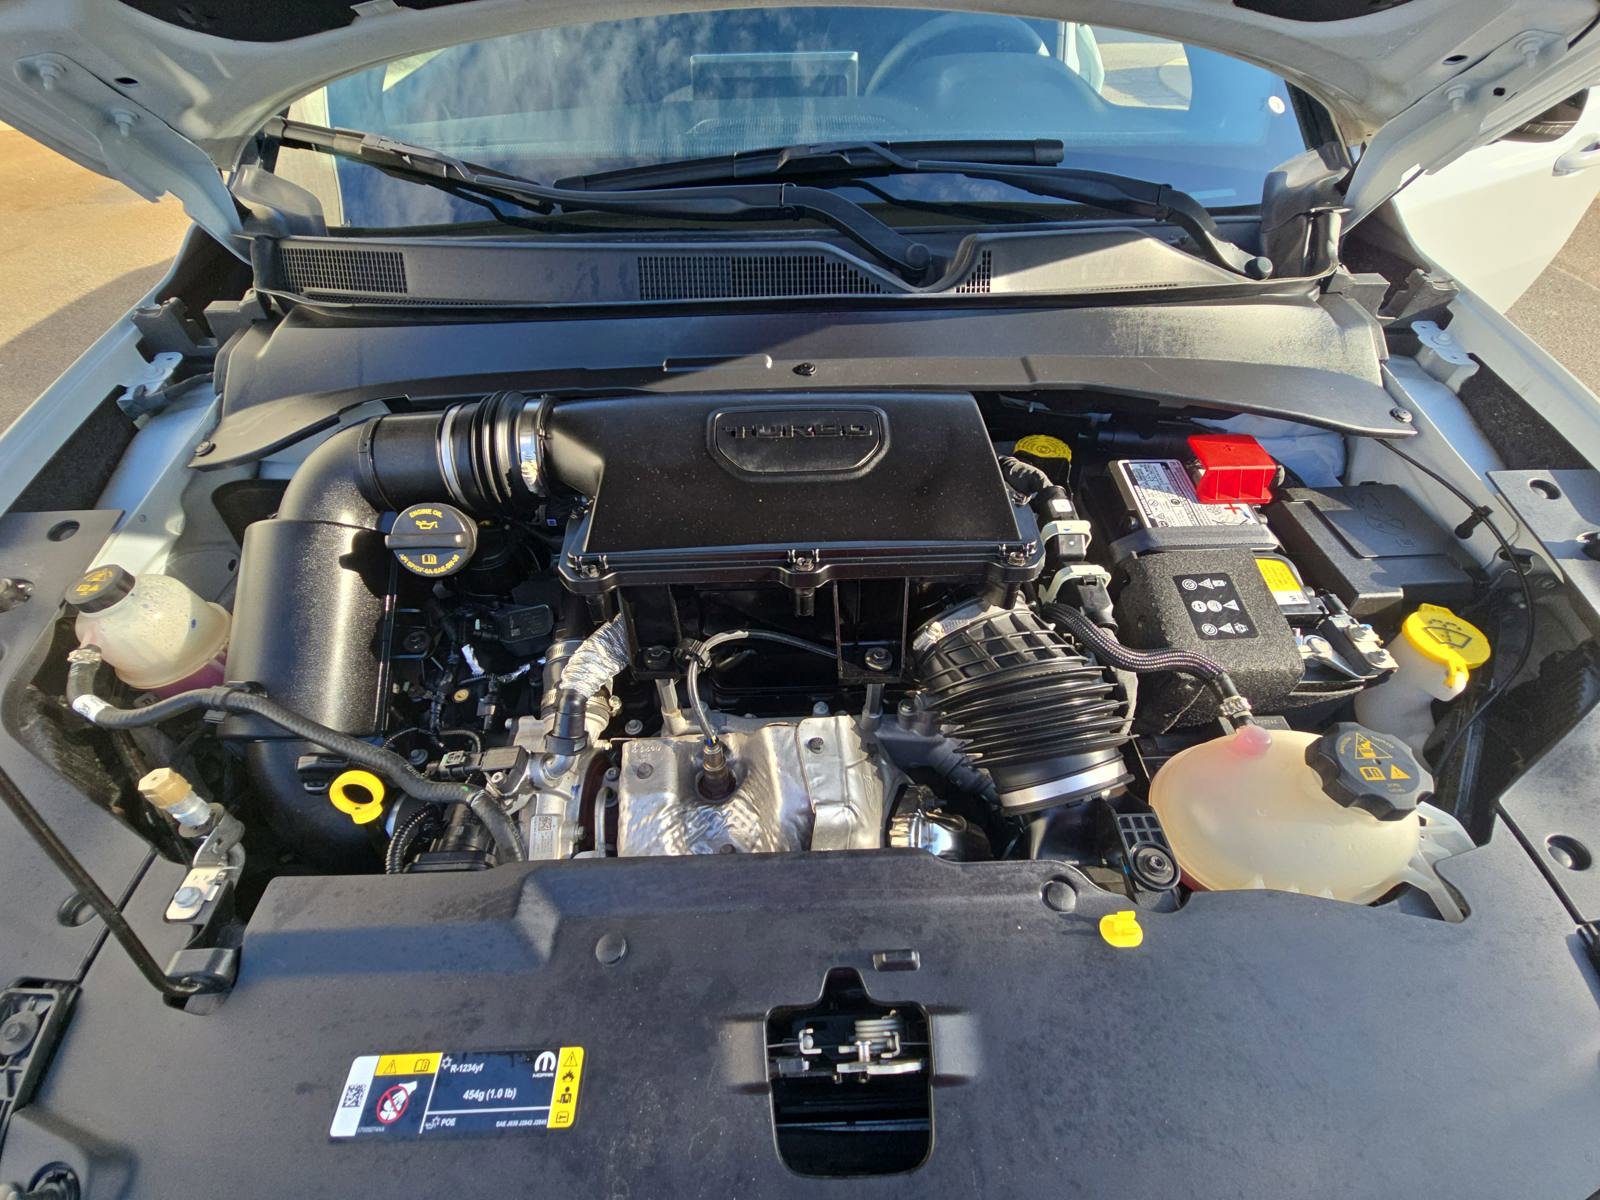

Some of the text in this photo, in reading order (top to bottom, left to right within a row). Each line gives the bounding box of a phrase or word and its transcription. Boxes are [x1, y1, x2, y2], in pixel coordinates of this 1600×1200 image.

[409, 508, 443, 518] ENGINE OIL
[450, 1062, 484, 1074] R-1234yf
[463, 1087, 518, 1102] 454g (1.0 lb)
[440, 1117, 457, 1127] POE
